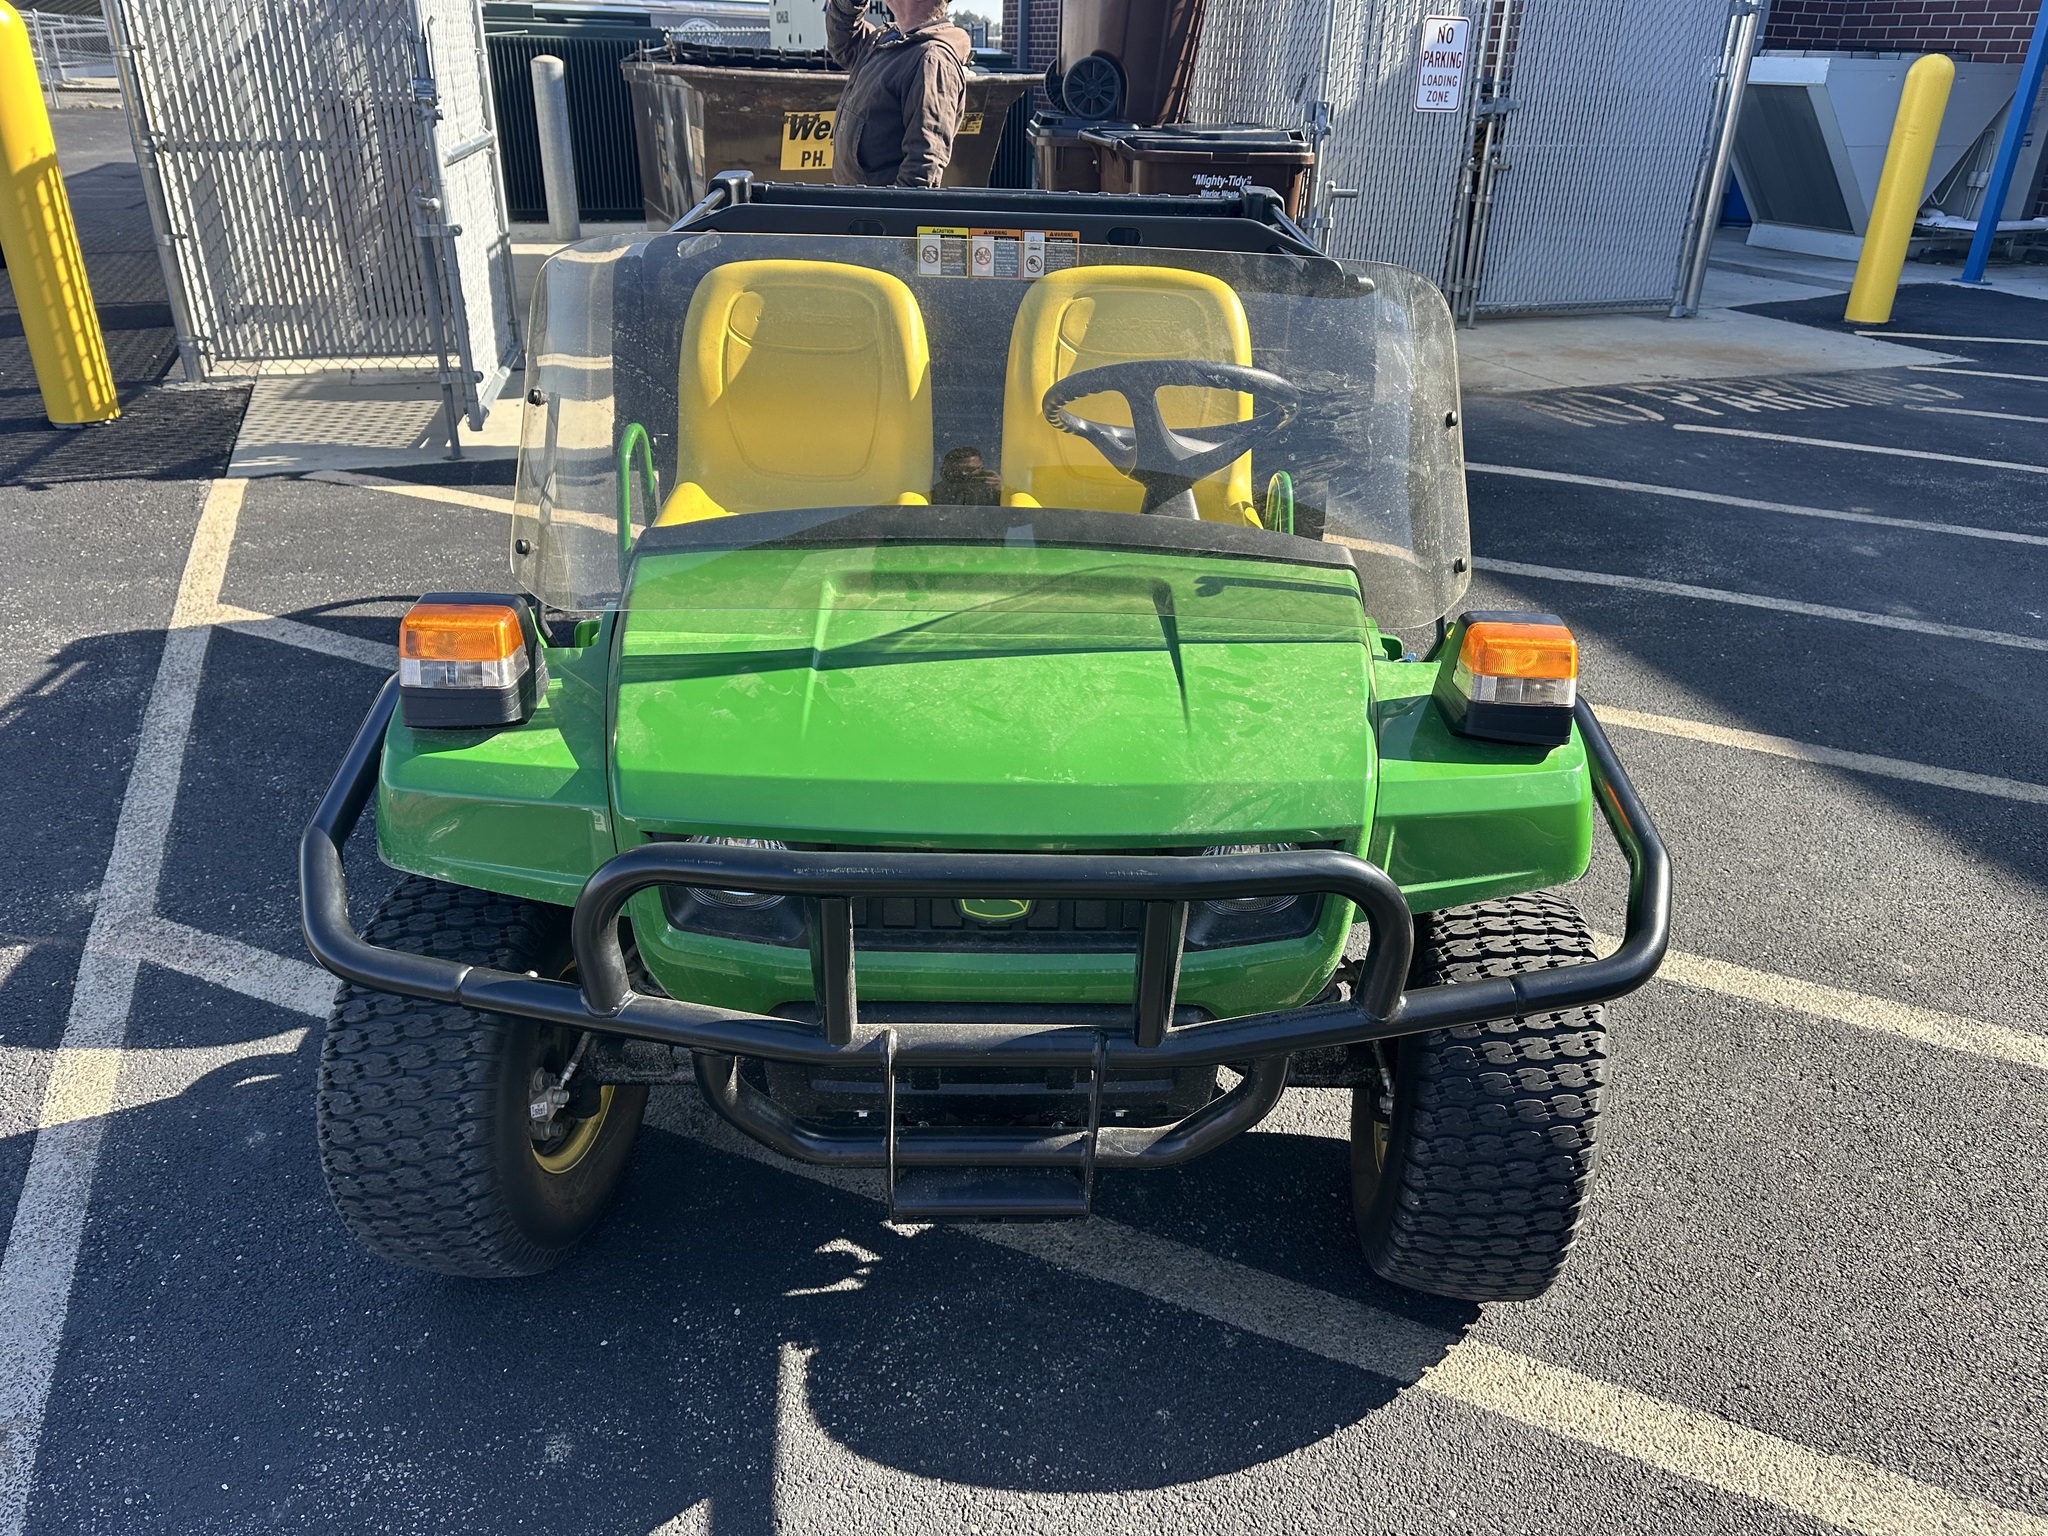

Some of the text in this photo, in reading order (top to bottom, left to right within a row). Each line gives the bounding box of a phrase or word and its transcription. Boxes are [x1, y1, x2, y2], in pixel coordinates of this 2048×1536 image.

[1436, 26, 1454, 45] NO
[1422, 50, 1463, 69] PARKING
[1422, 74, 1458, 88] LOADING
[1426, 90, 1450, 103] ZONE
[800, 149, 826, 168] PH.
